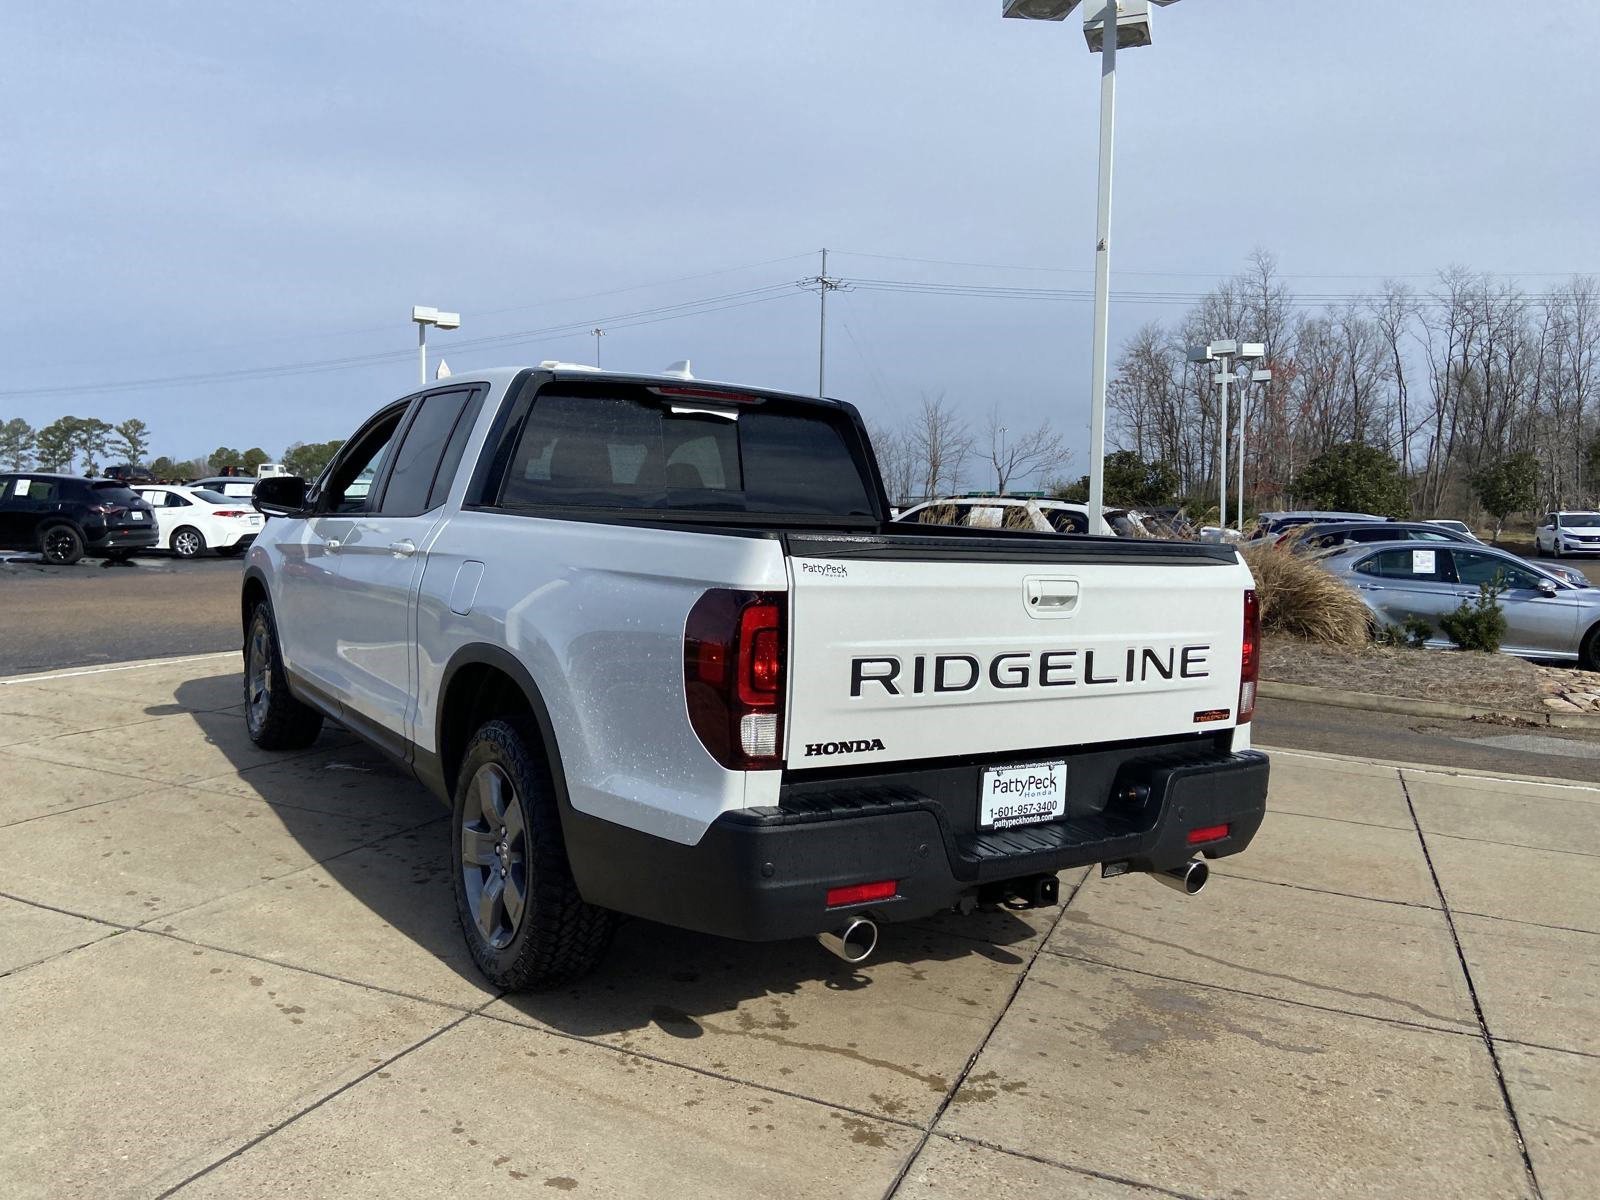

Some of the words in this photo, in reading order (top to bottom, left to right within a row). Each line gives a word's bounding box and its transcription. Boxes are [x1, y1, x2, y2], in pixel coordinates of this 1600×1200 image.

[802, 563, 848, 576] PattyPeck
[850, 645, 1211, 697] RIDGELINE
[804, 739, 886, 756] HONDA
[993, 772, 1057, 796] PattyPeck
[1024, 790, 1052, 798] Honda
[990, 800, 1057, 818] 1-601-957-3400
[993, 814, 1054, 830] pattypeckhonda.com
